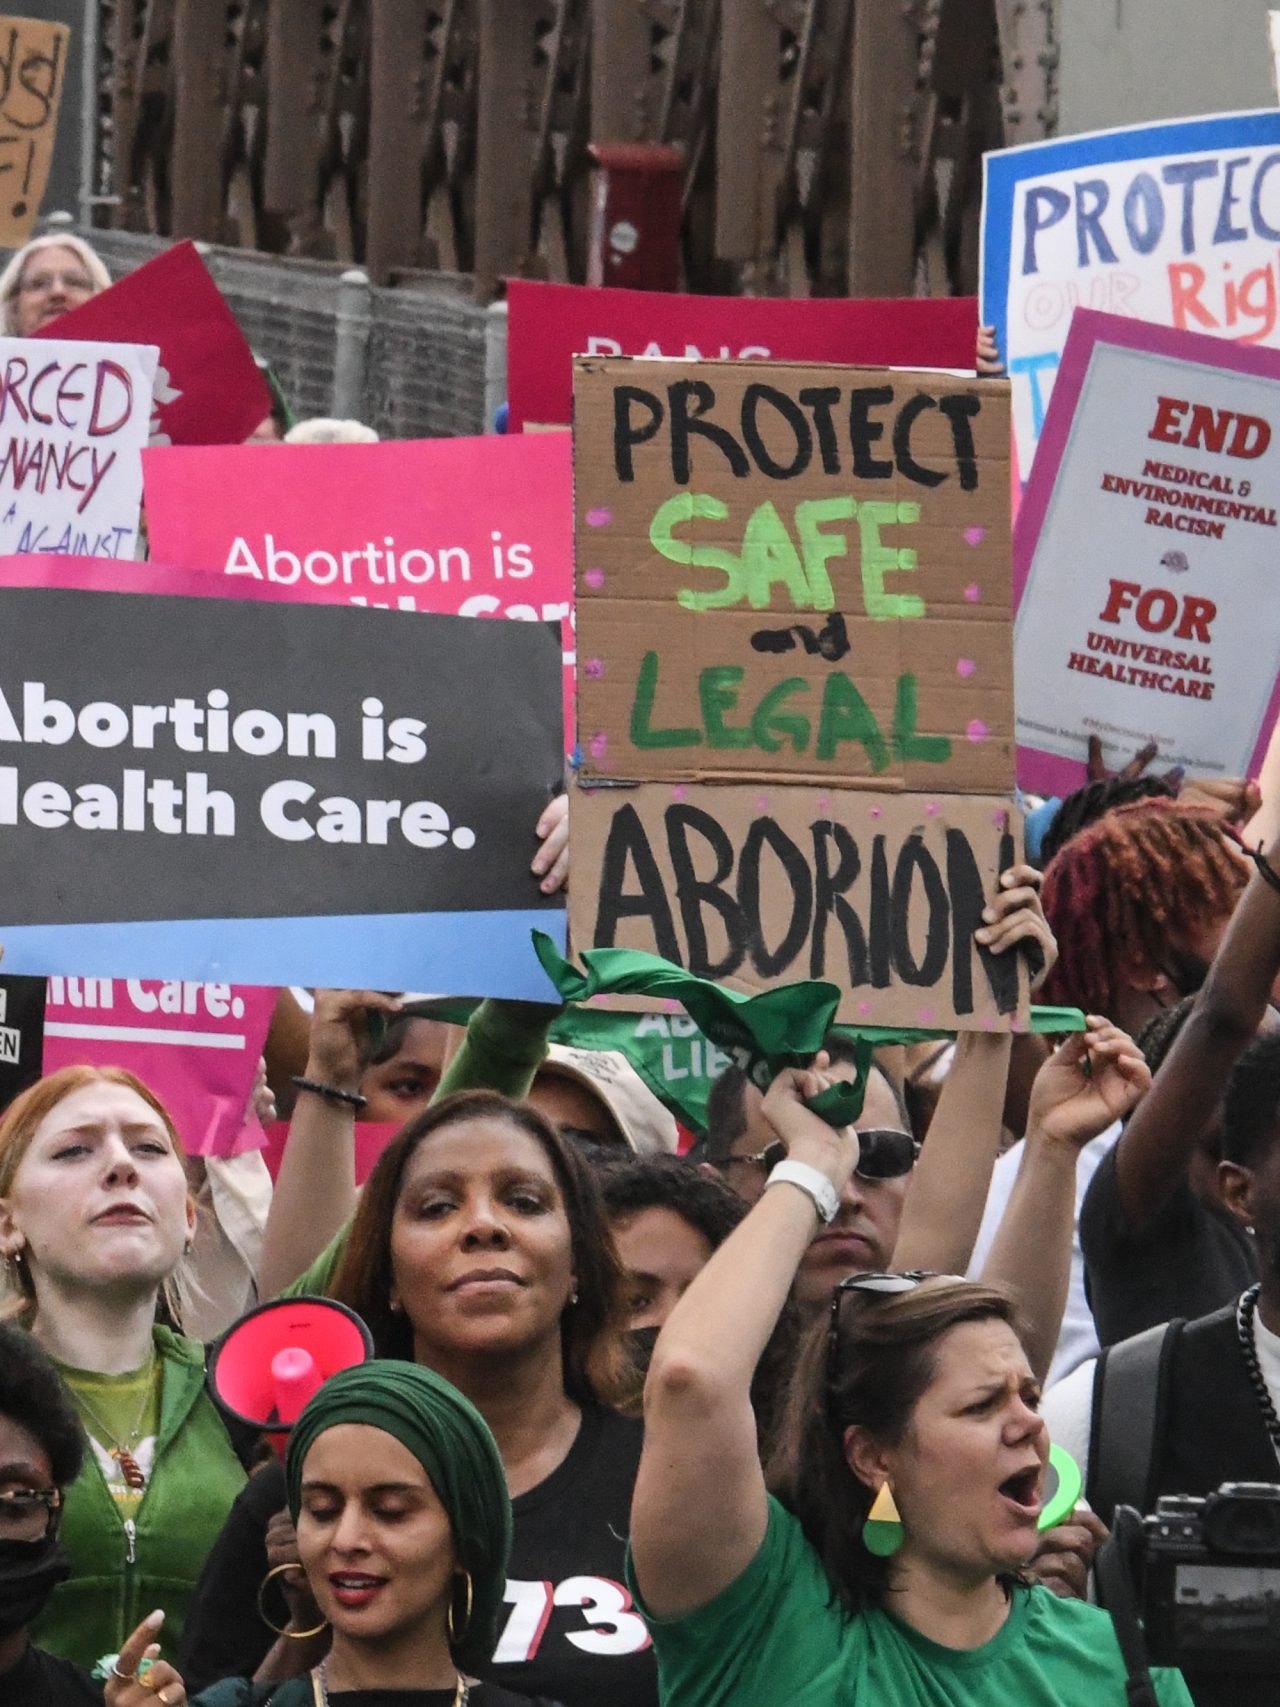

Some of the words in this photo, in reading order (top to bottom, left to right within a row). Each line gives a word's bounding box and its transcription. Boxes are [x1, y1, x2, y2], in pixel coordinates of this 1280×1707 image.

[613, 379, 982, 491] PROTECT
[1147, 395, 1273, 460] END
[1100, 472, 1278, 527] ENVIRONMENTAL
[1141, 459, 1234, 496] MEDICAL
[1237, 480, 1252, 498] &
[2, 502, 16, 523] A
[16, 520, 133, 559] AGAINST
[1144, 507, 1227, 541] RACISM
[224, 534, 471, 585] Abortion
[491, 531, 534, 580] is
[649, 491, 927, 622] SAFE
[750, 611, 852, 663] and
[1099, 578, 1218, 644] FOR
[1066, 651, 1216, 702] HEALTHCARE
[1086, 631, 1213, 676] UNIVERSAL
[362, 696, 429, 764] is
[630, 650, 954, 774] LEGAL
[259, 779, 477, 850] Care.
[594, 802, 1022, 1016] ABORION
